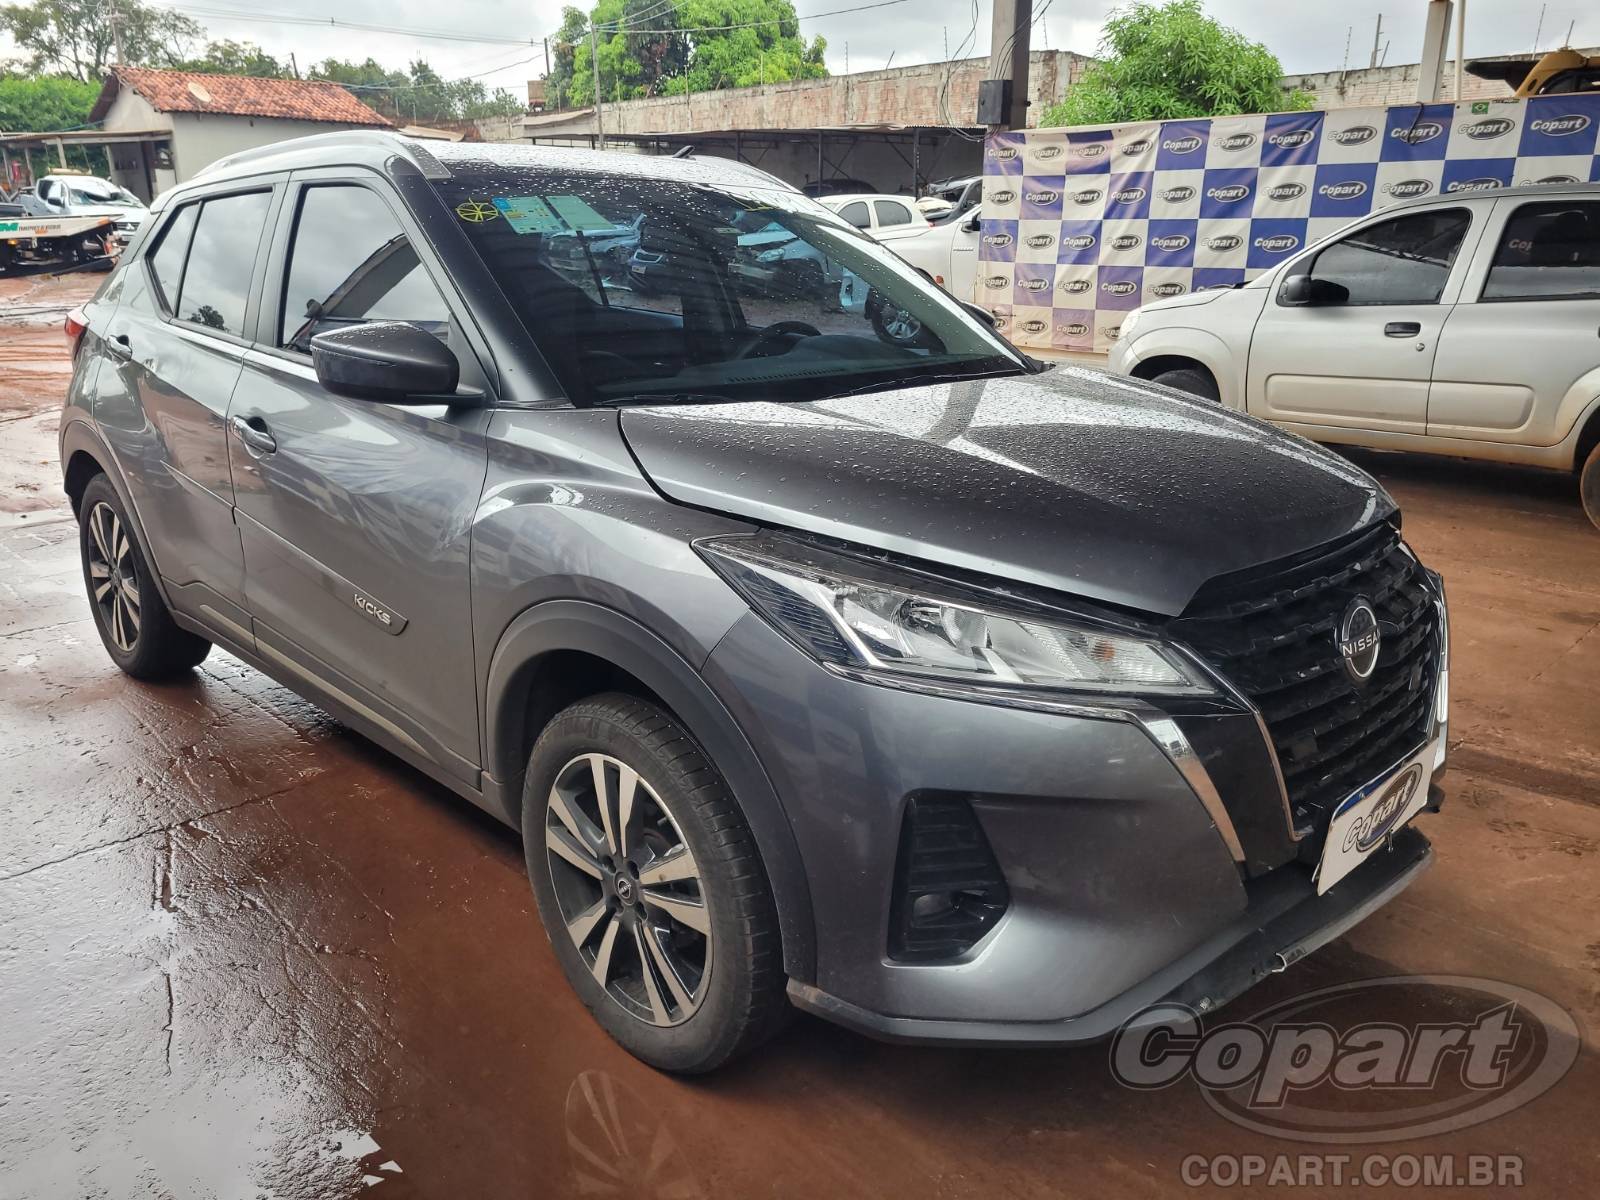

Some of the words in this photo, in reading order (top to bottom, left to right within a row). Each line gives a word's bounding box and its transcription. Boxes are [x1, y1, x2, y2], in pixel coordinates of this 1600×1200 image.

[1458, 120, 1508, 138] Copart
[1530, 116, 1584, 134] Copart
[1213, 134, 1251, 149] Copart
[1269, 130, 1309, 148] Copart
[1327, 126, 1370, 144] Copart
[1163, 137, 1197, 151] Copart
[988, 147, 1015, 159] Copart
[1156, 187, 1191, 201] Copart
[1207, 186, 1244, 201] Copart
[1263, 184, 1302, 200] Copart
[1319, 183, 1362, 199] Copart
[1381, 181, 1425, 195] Copart
[1025, 191, 1054, 203] Copart
[1069, 190, 1098, 203] Copart
[1111, 189, 1141, 202] Copart
[983, 235, 1009, 247] Copart
[1063, 236, 1092, 248] Copart
[1104, 235, 1137, 248] Copart
[1151, 236, 1185, 250] Copart
[1201, 236, 1238, 250] Copart
[1254, 236, 1292, 250] Copart
[1018, 278, 1045, 290] Copart
[1058, 280, 1088, 292] Copart
[1101, 282, 1132, 295] Copart
[1147, 283, 1183, 297] Copart
[1057, 324, 1085, 336] Copart
[354, 594, 391, 625] KICKS
[1342, 631, 1379, 657] NISSA
[1342, 772, 1415, 853] Copart
